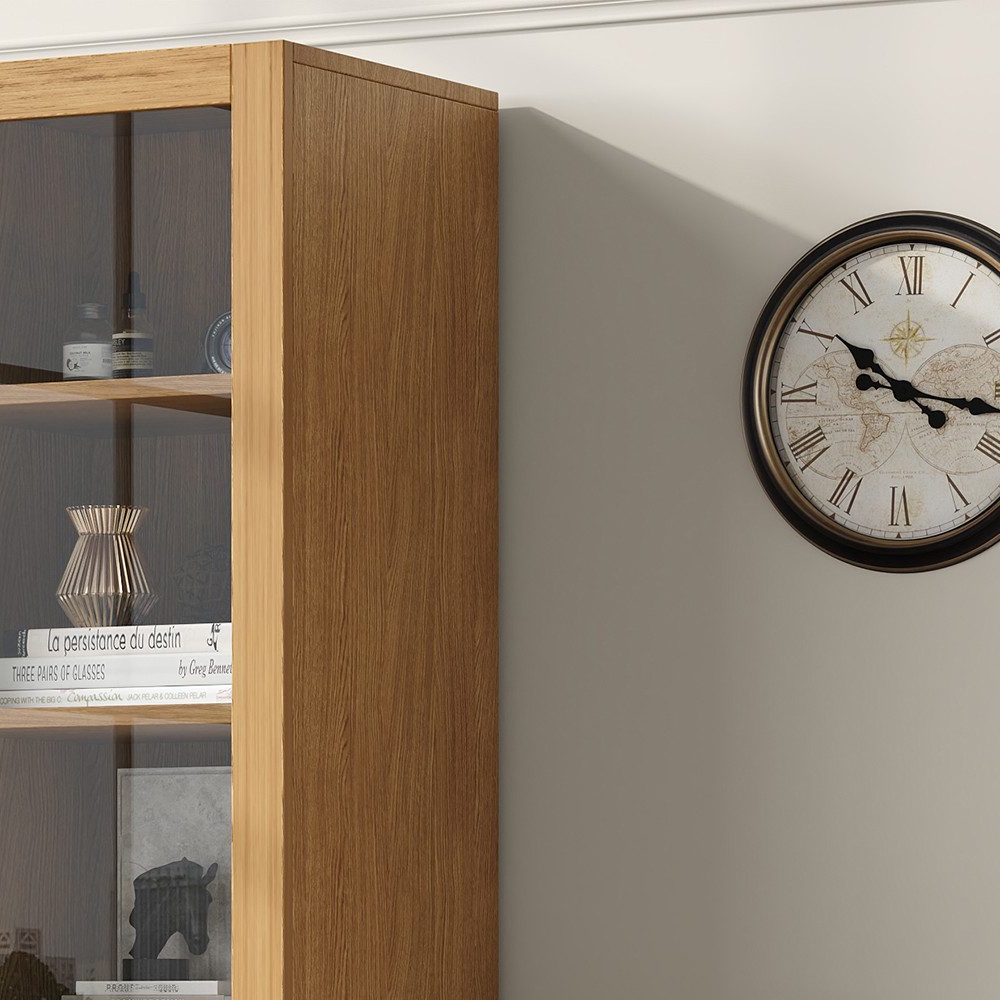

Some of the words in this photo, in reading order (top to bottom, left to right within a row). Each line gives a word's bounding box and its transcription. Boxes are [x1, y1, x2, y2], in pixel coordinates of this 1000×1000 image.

[839, 270, 873, 314] XI
[895, 256, 924, 295] XII
[950, 272, 975, 308] I
[781, 380, 817, 405] IX
[789, 426, 830, 472] VIII
[828, 467, 863, 514] VII
[889, 486, 911, 526] VI
[946, 473, 970, 512] V
[47, 630, 60, 652] La
[64, 628, 126, 656] persistance
[130, 626, 144, 650] du
[149, 624, 182, 650] destin
[12, 666, 34, 682] THREE
[38, 666, 58, 682] PAIRS
[60, 665, 70, 681] OF
[72, 664, 105, 680] GLASSES
[178, 660, 188, 679] by
[189, 659, 206, 678] Greg
